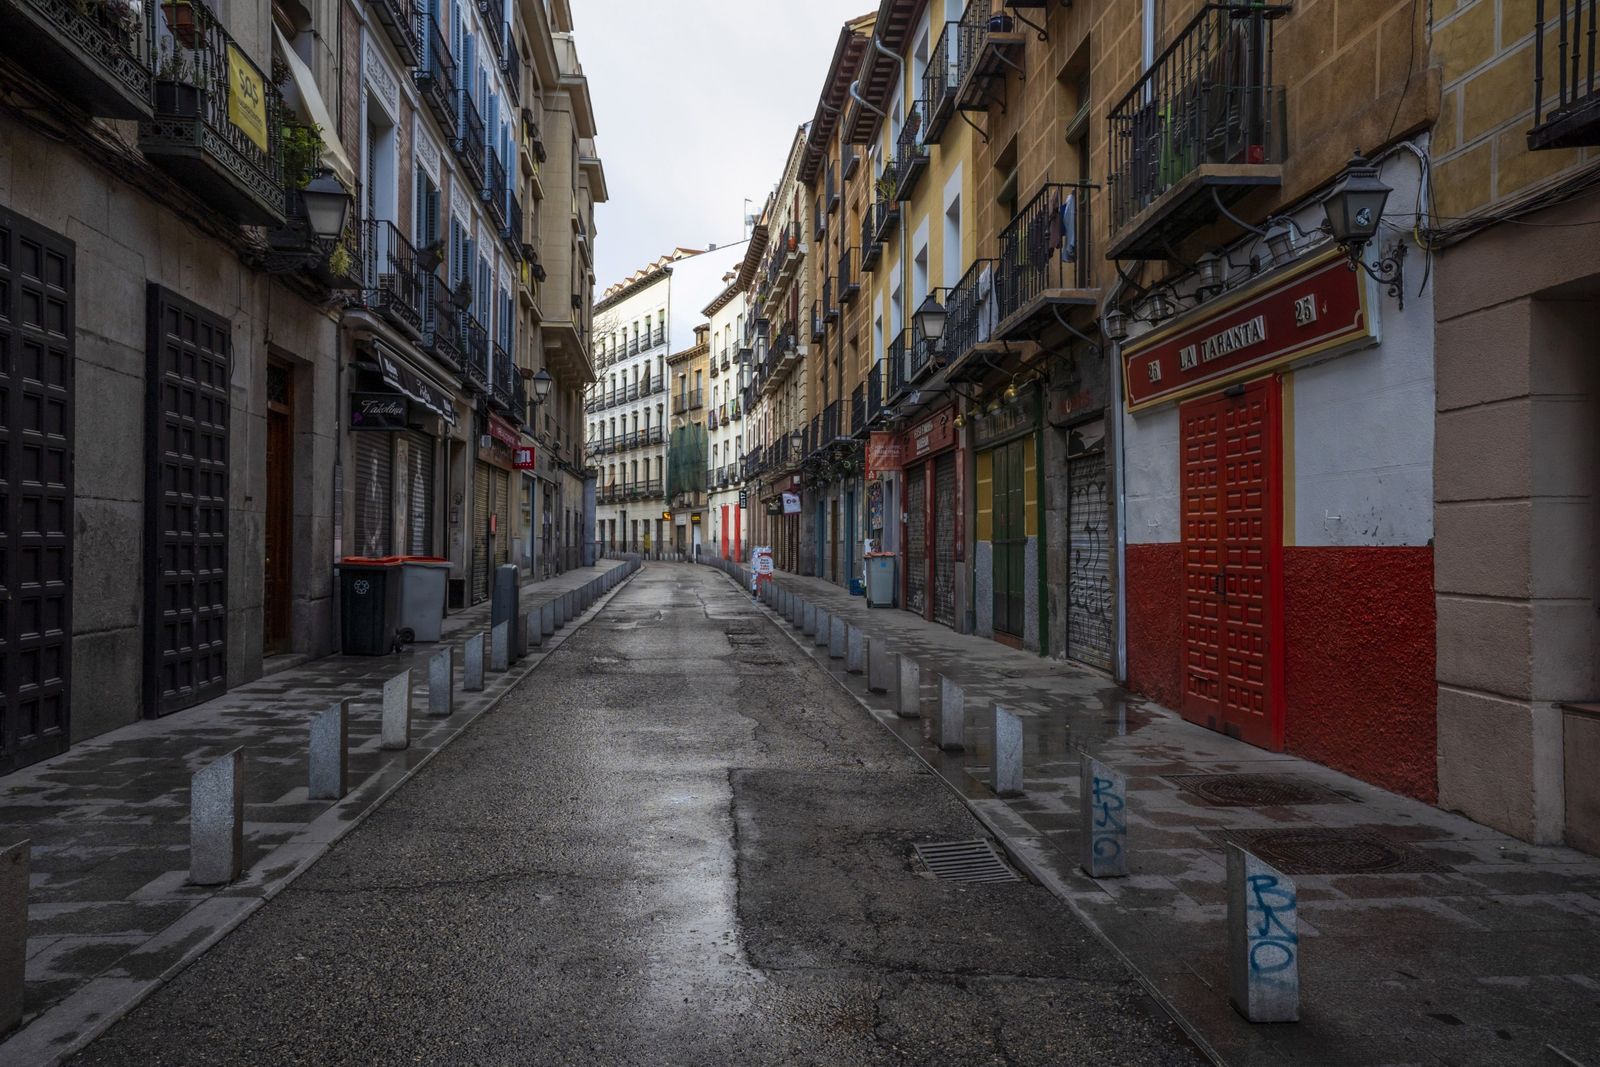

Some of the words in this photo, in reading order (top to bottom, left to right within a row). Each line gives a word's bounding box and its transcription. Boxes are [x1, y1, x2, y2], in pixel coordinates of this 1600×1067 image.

[1148, 363, 1158, 380] 25
[1179, 350, 1194, 369] LA
[1201, 318, 1262, 361] TARANTA
[1296, 299, 1312, 322] 25
